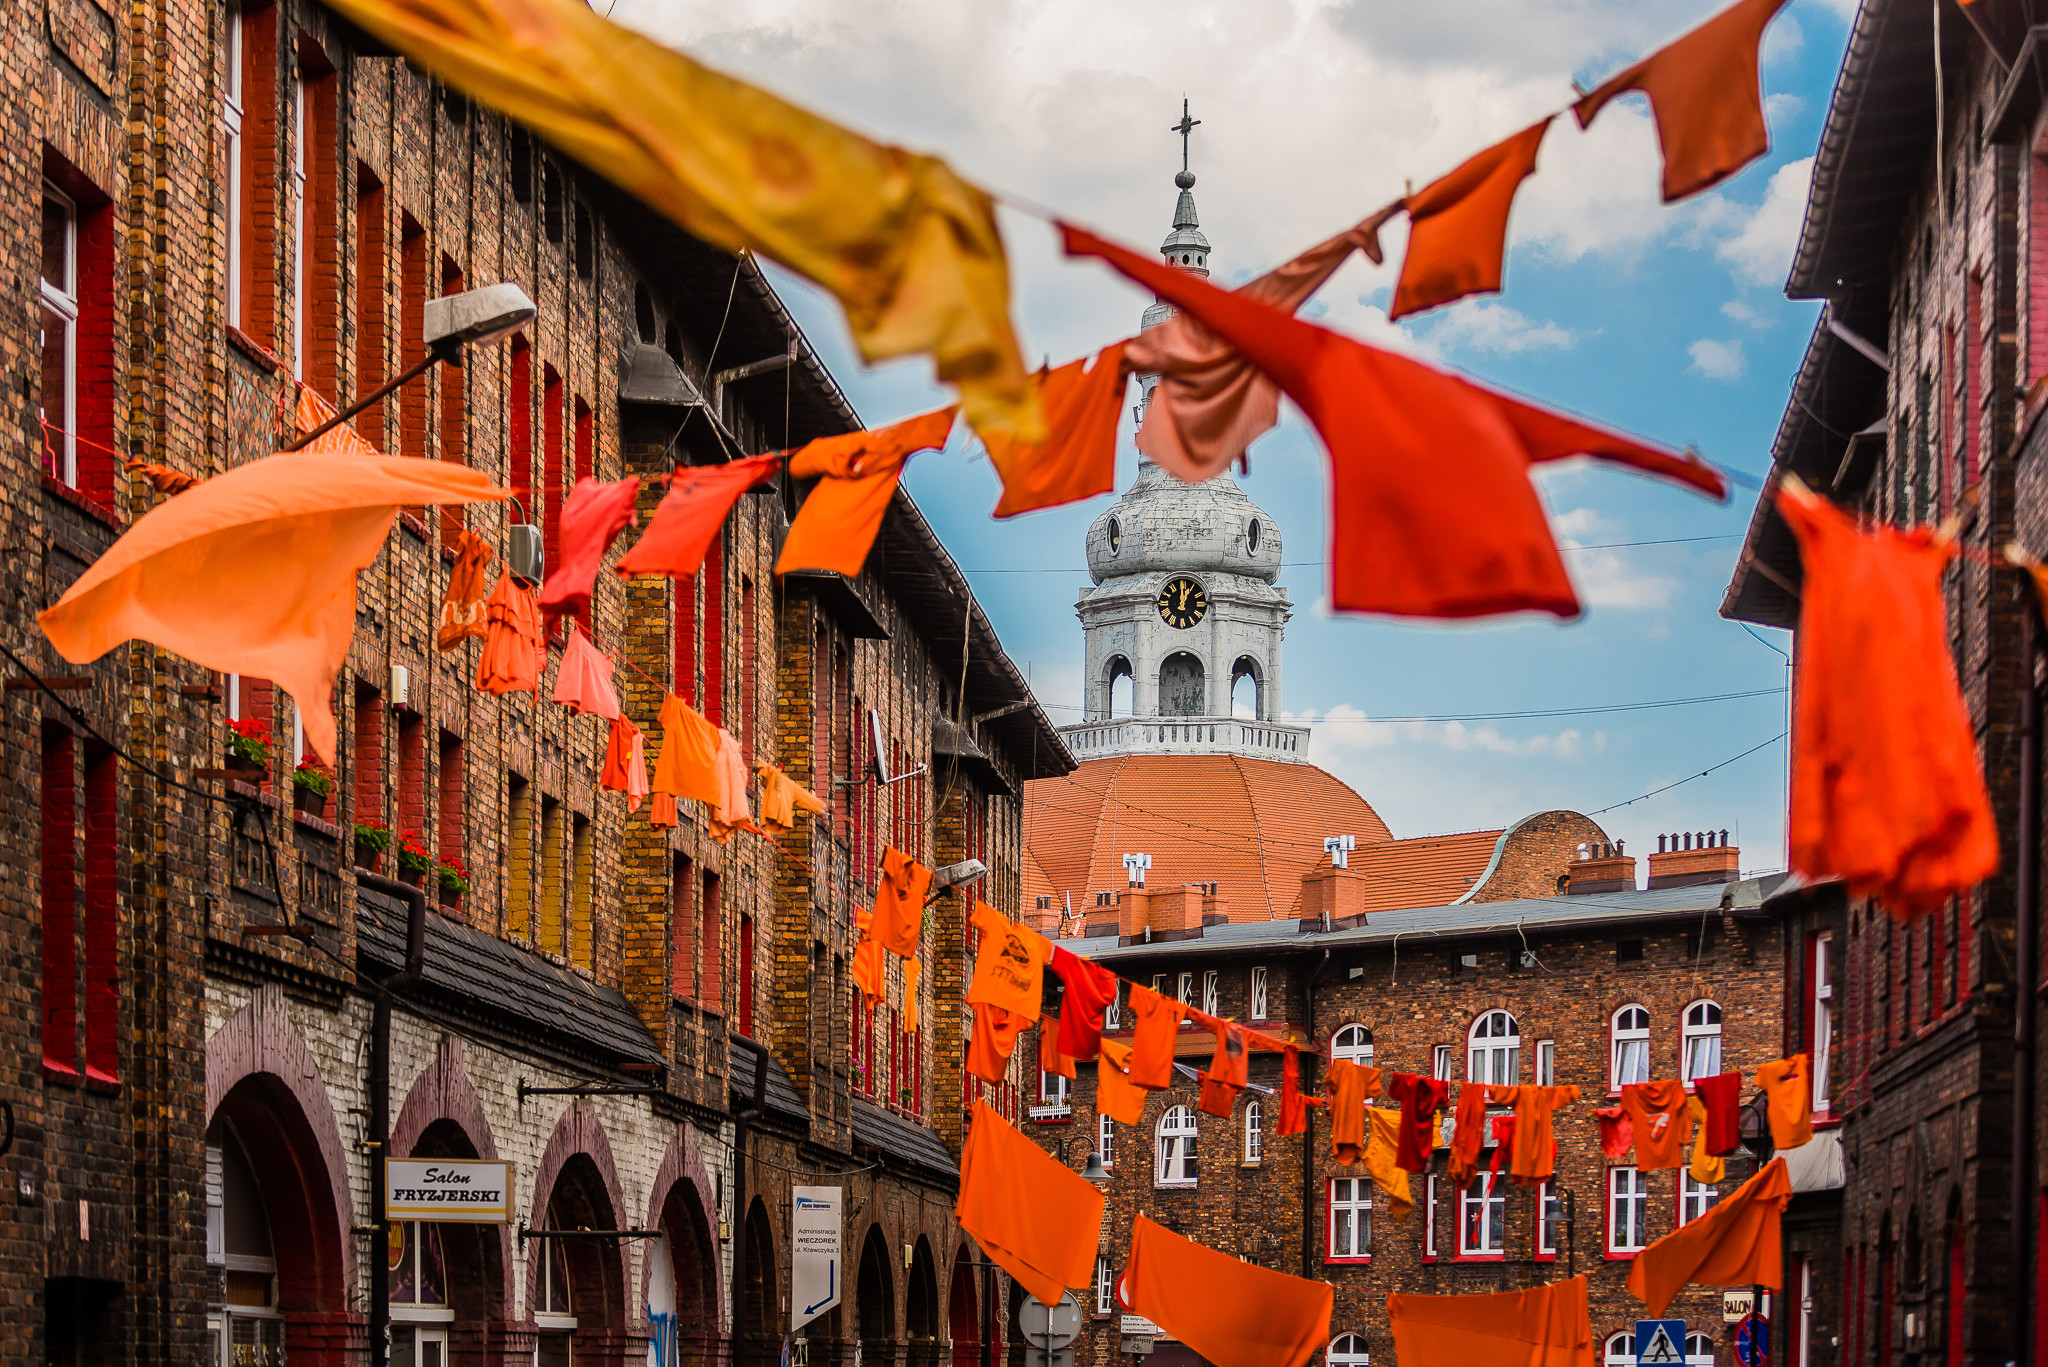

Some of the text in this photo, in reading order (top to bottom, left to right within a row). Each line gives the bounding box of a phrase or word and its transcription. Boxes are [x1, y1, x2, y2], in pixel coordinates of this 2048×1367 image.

[423, 1168, 471, 1184] Salon
[393, 1189, 500, 1202] FRYZJERSKI
[1724, 1300, 1752, 1314] SALON
